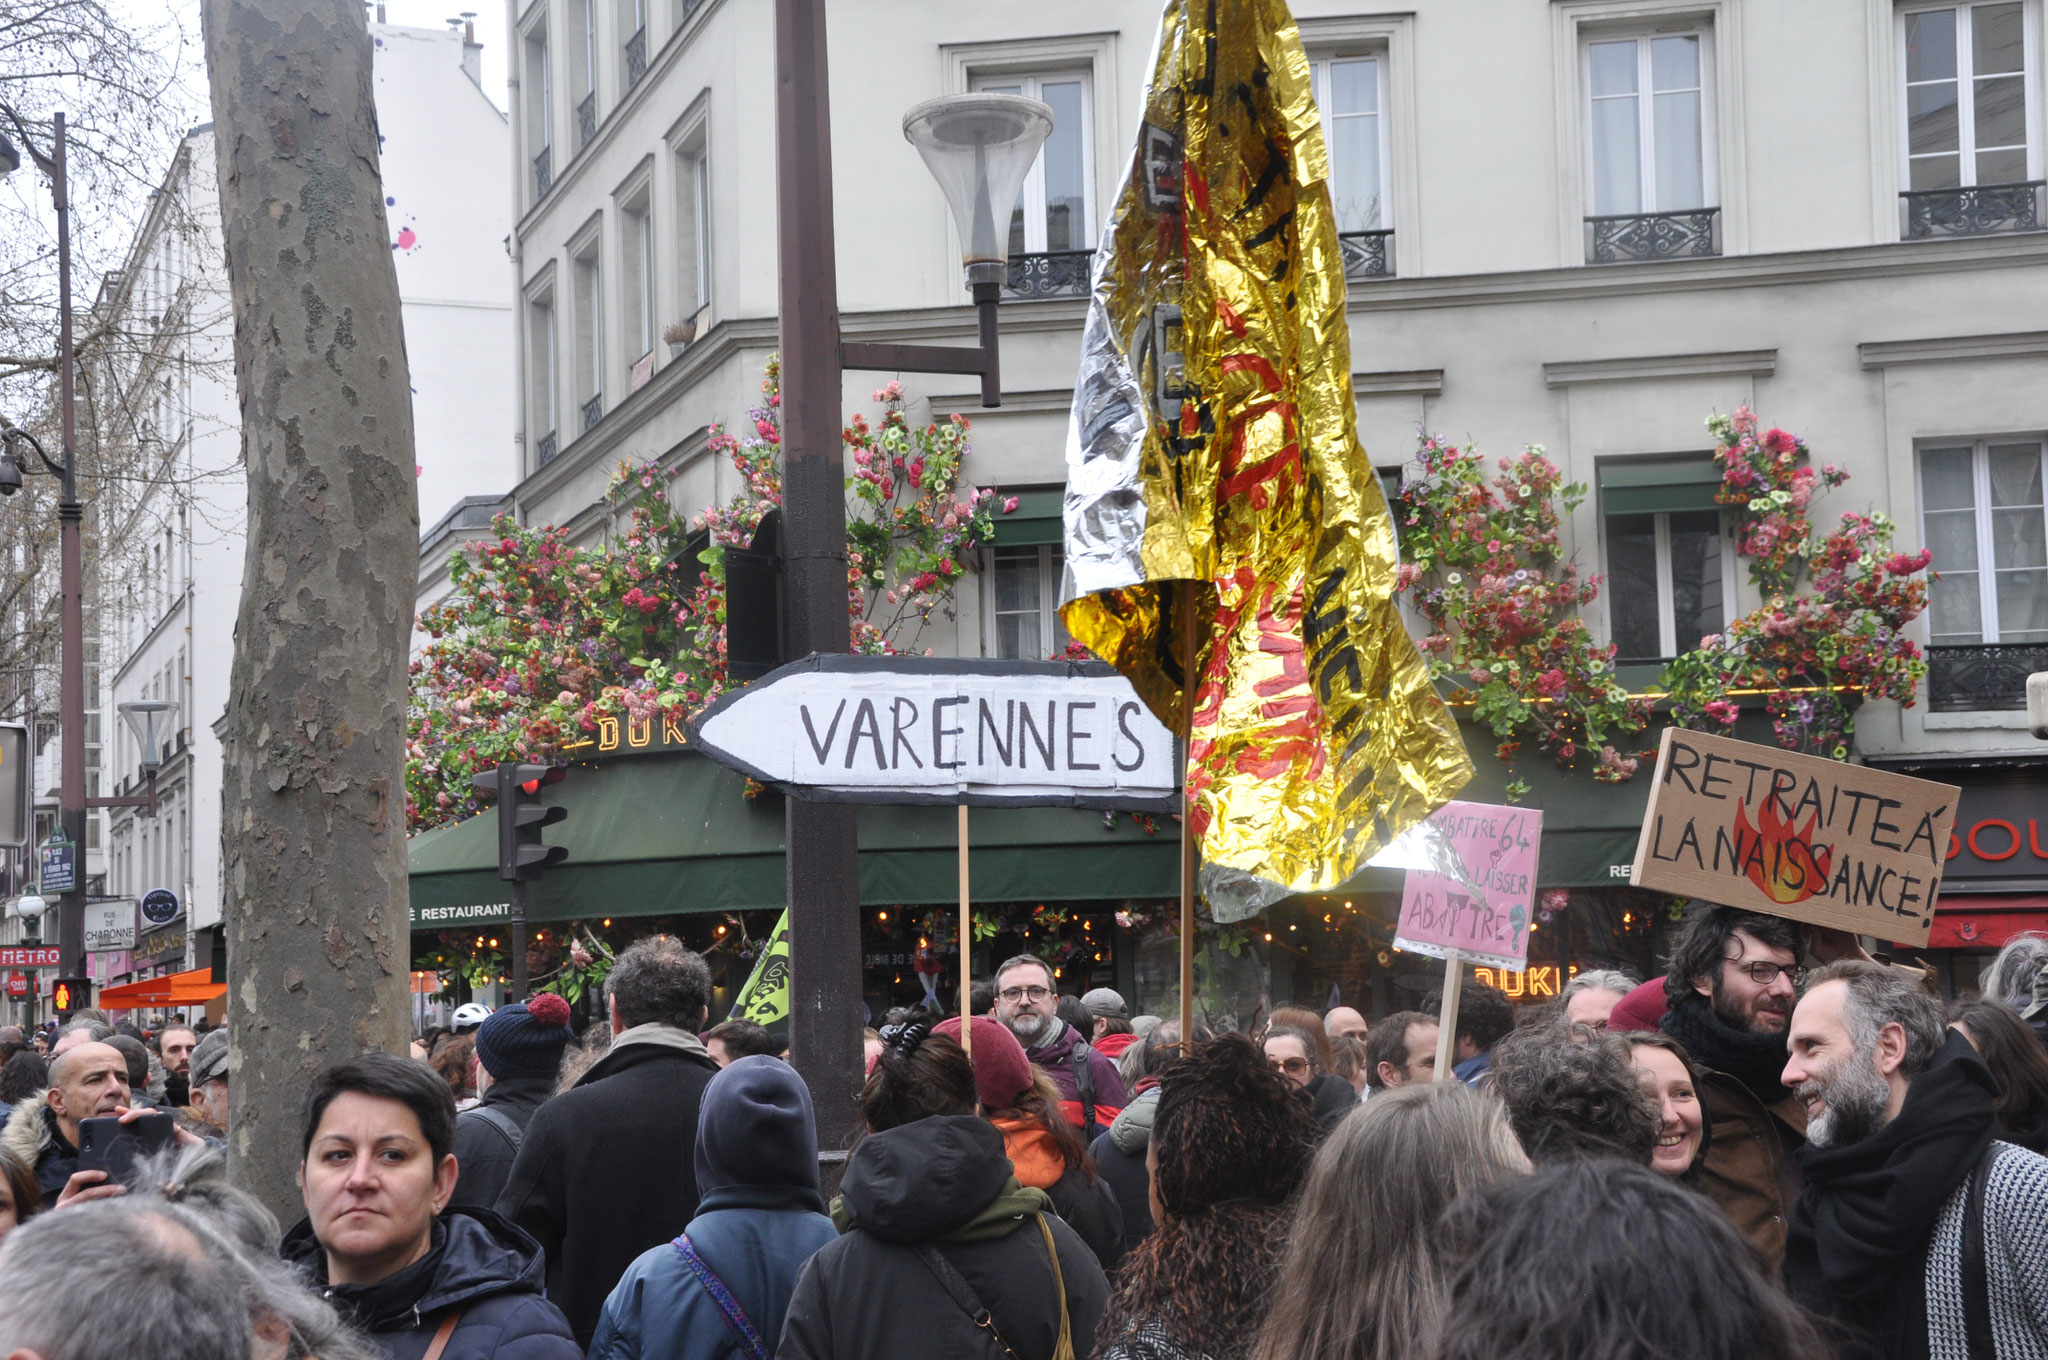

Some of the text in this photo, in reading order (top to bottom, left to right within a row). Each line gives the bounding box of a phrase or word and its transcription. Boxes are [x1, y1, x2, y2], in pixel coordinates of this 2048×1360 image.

[800, 695, 1146, 772] VARENNES
[1663, 740, 1904, 852] RETRAITE
[1435, 814, 1530, 853] MBATTRE 64
[1475, 866, 1528, 895] LAISSER
[1610, 865, 1634, 878] RE
[1651, 814, 1939, 929] LA NAISSANCE!
[104, 911, 116, 919] RUE
[421, 903, 510, 920] RESTAURANT
[85, 927, 134, 942] CHARONNE
